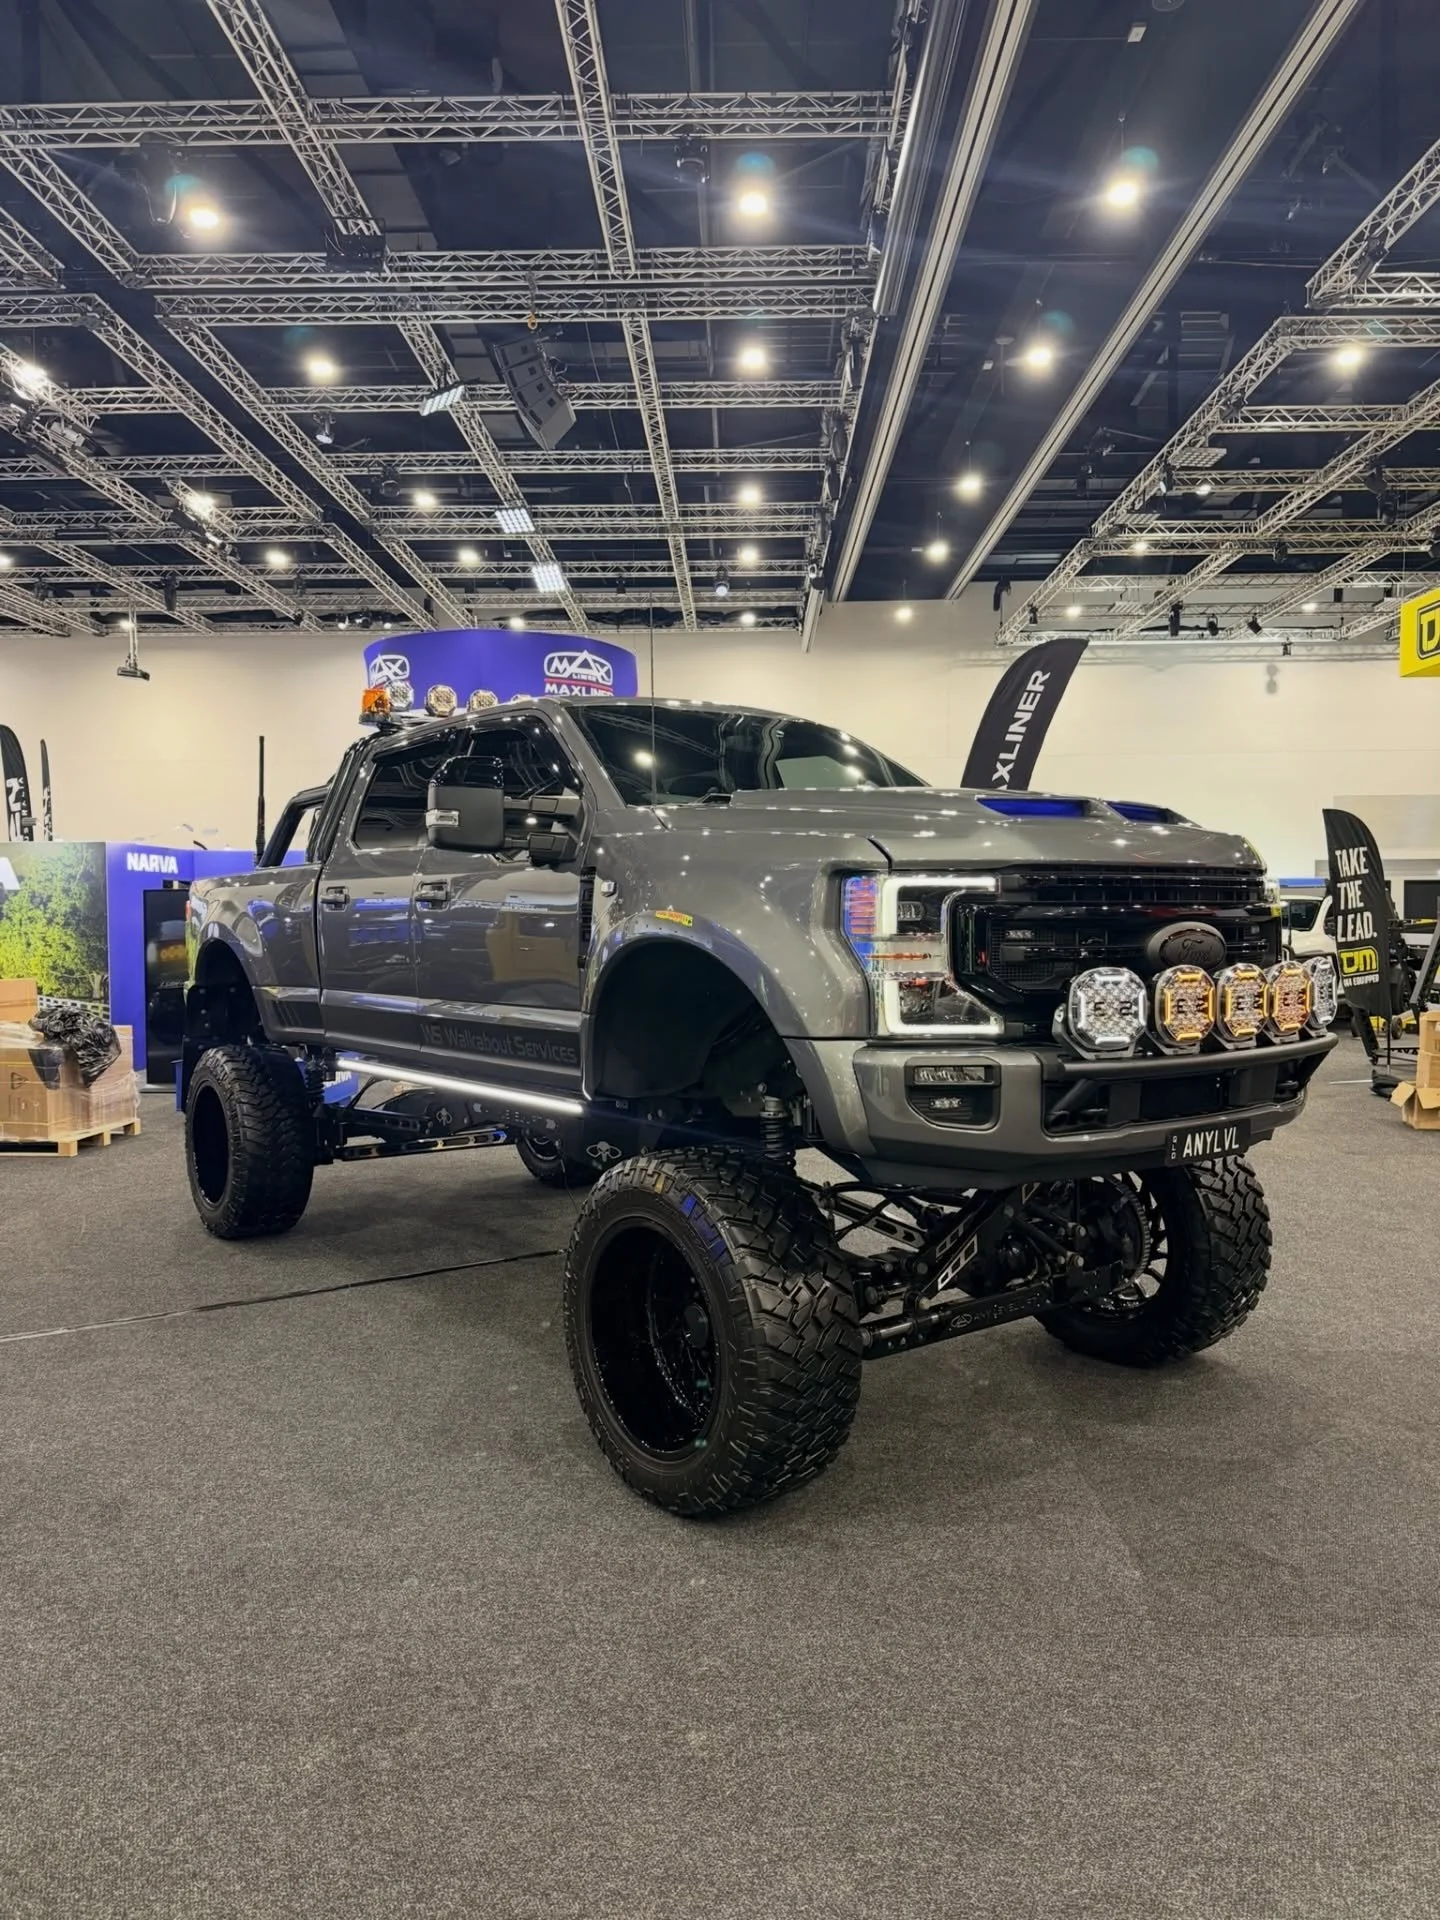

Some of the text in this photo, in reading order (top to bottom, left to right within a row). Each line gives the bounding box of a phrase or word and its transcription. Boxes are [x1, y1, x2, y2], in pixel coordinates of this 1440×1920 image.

[548, 649, 612, 684] MAX
[991, 670, 1051, 790] XLINER
[127, 852, 179, 874] NARVA
[1335, 846, 1369, 878] TAKE
[1337, 880, 1364, 910] THE
[1337, 911, 1378, 942] LEAD.
[443, 1025, 514, 1054] Walkabout
[514, 1036, 578, 1064] Services
